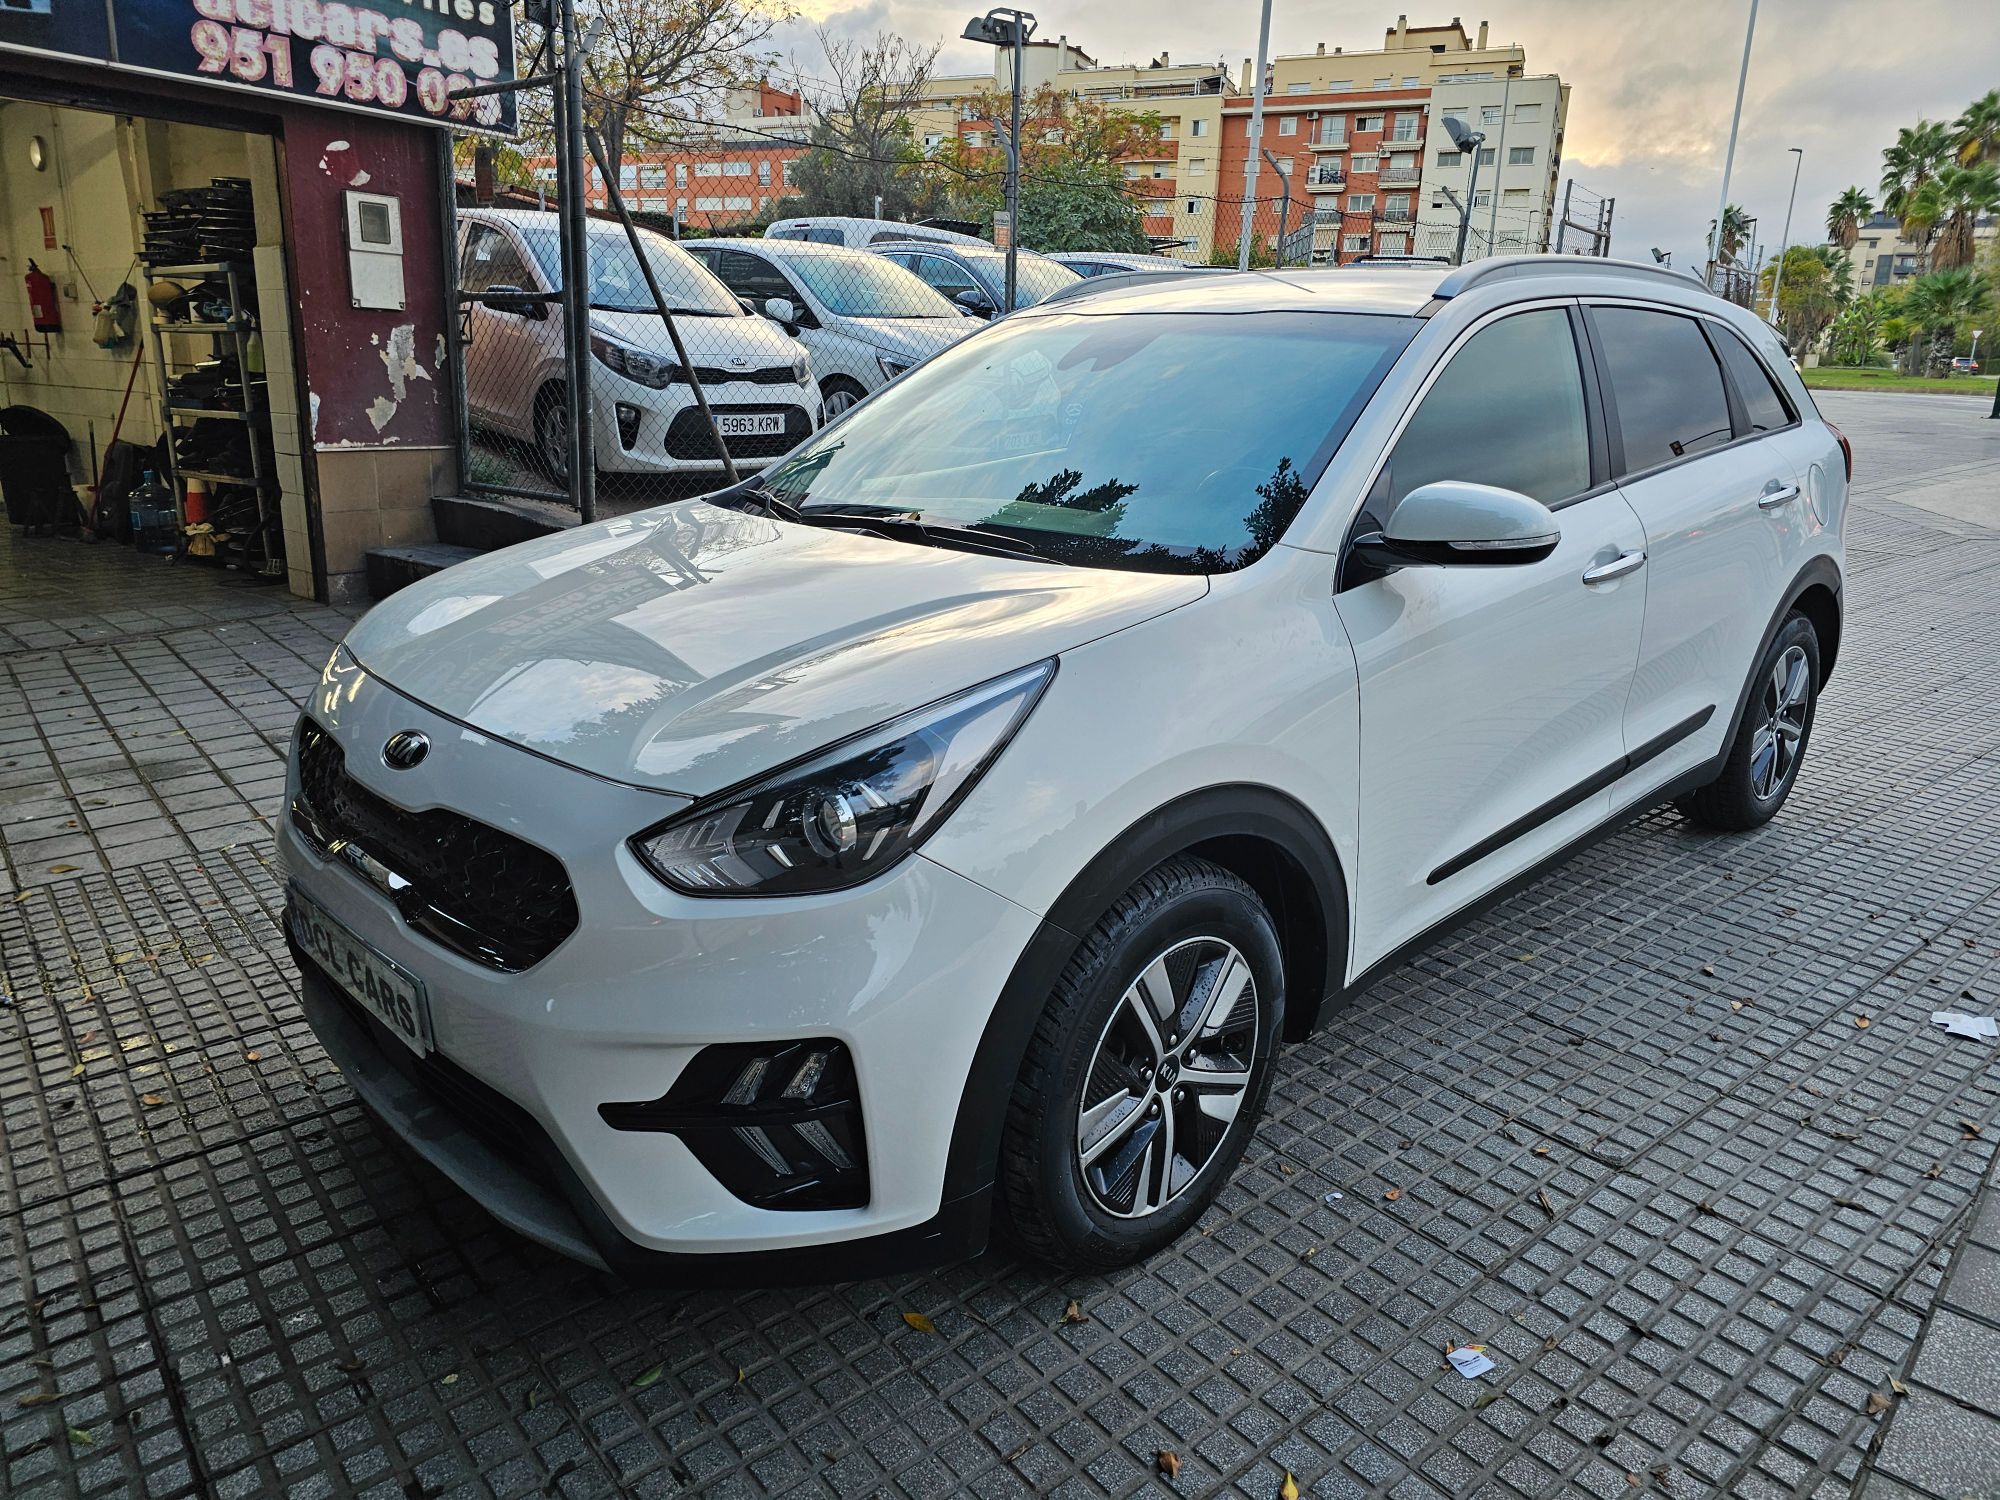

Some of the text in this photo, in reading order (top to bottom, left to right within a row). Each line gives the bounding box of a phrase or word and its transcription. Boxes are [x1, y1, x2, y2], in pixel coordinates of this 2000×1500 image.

[191, 20, 294, 88] 951
[310, 44, 408, 108] 950
[722, 416, 780, 433] 5963 KRW
[346, 950, 416, 1038] CARS
[1160, 1063, 1177, 1086] KIA
